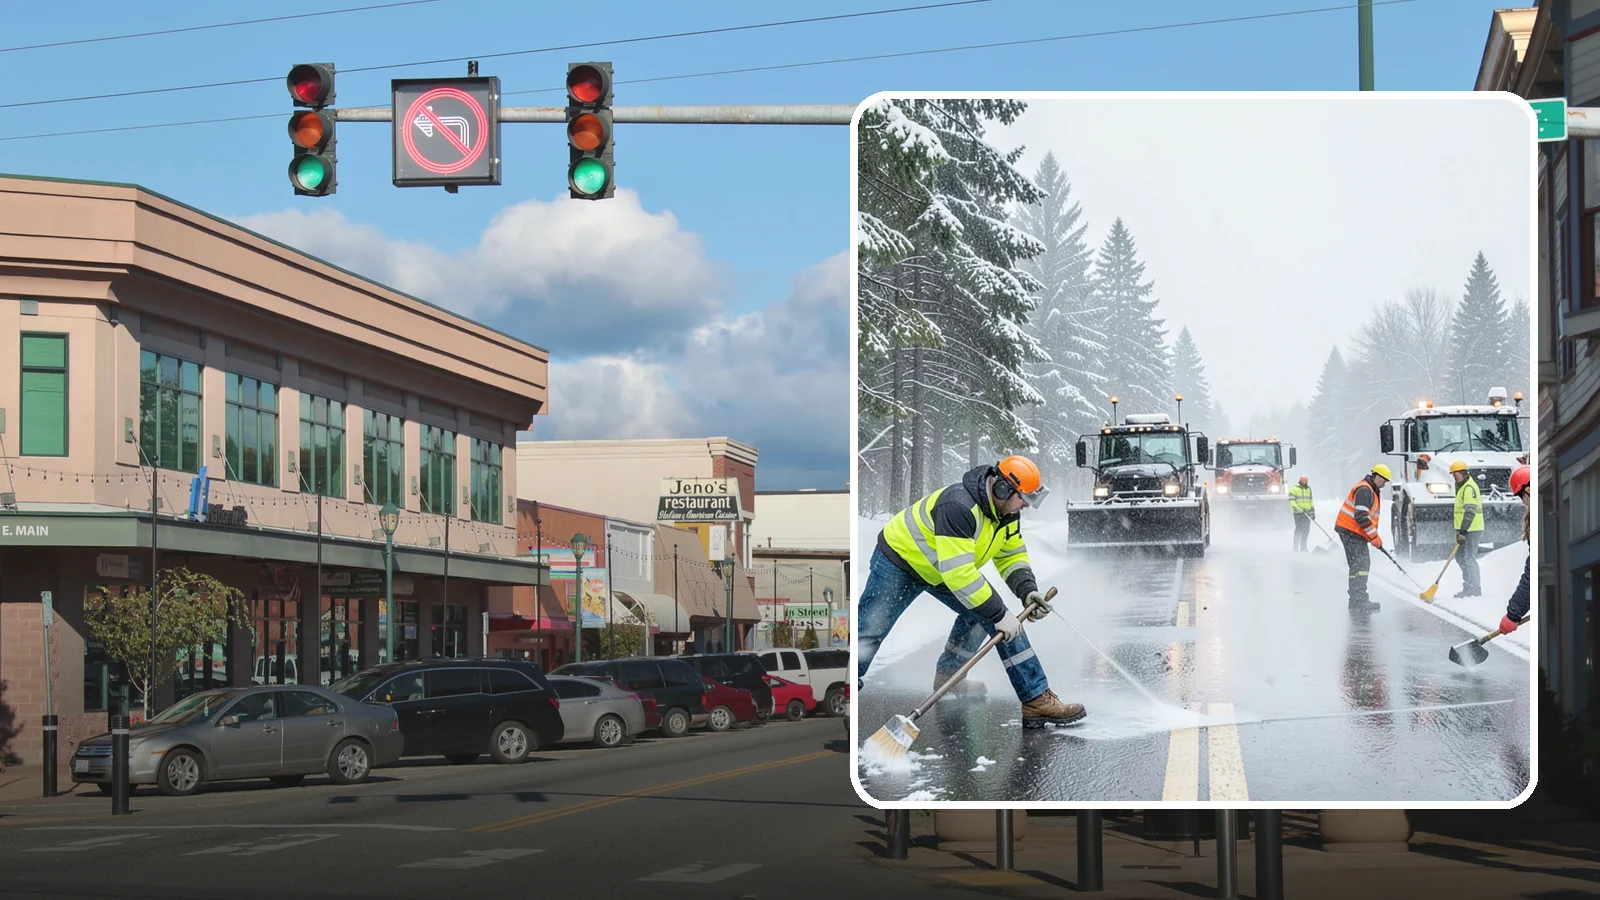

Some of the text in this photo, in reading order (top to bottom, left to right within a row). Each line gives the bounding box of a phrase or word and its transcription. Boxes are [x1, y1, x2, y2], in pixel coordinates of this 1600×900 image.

[670, 480, 728, 494] Jeno's
[665, 496, 731, 509] restaurant
[658, 510, 682, 519] Italian
[686, 510, 715, 519] American
[715, 509, 737, 519] Cuisine
[2, 525, 49, 536] E. MAIN
[797, 607, 829, 617] Street
[791, 619, 824, 627] lass
